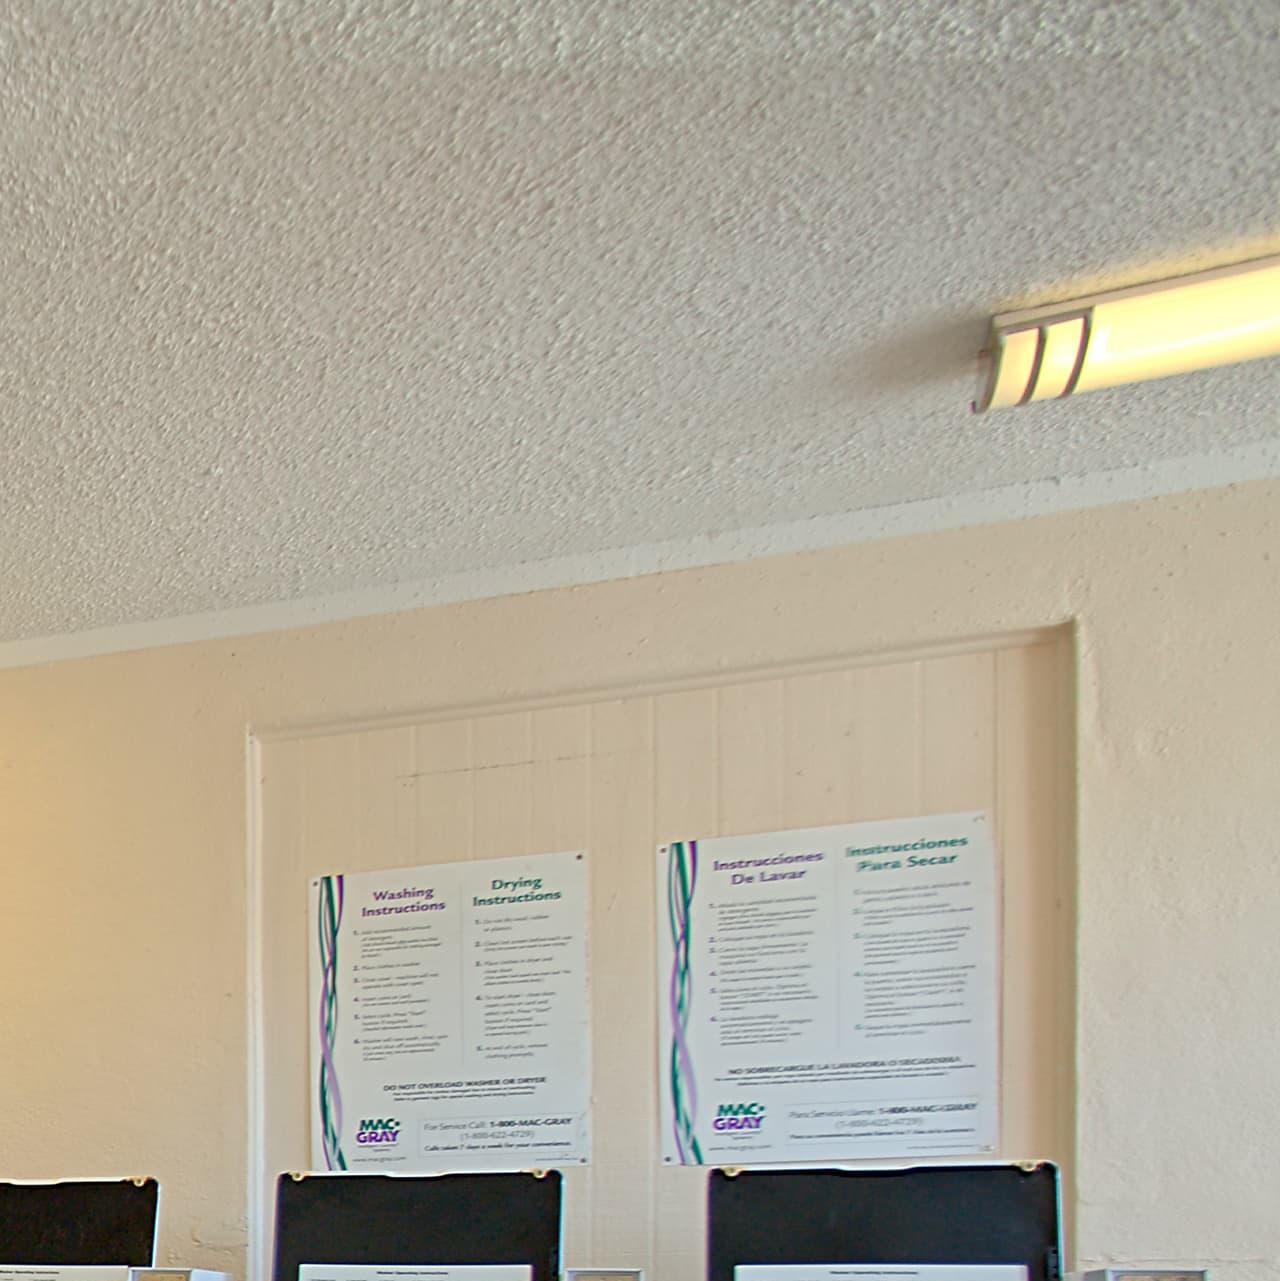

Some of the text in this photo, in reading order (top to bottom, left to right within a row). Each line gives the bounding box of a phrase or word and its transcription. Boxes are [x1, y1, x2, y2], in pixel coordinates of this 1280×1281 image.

[845, 837, 969, 858] Instrucciones
[713, 853, 824, 871] Instrucciones
[856, 854, 959, 872] Para Secar
[492, 877, 542, 892] Drying
[731, 870, 807, 885] De Lavar
[373, 887, 434, 901] Washing
[473, 891, 561, 907] Instructions
[362, 901, 446, 917] Instructions
[383, 1084, 397, 1092] DO
[398, 1083, 416, 1091] NOT
[418, 1081, 464, 1090] OVERLOAD
[465, 1079, 500, 1087] WASHER
[424, 1123, 438, 1131] For
[713, 1115, 766, 1130] GRAY
[356, 1130, 401, 1143] GRAY
